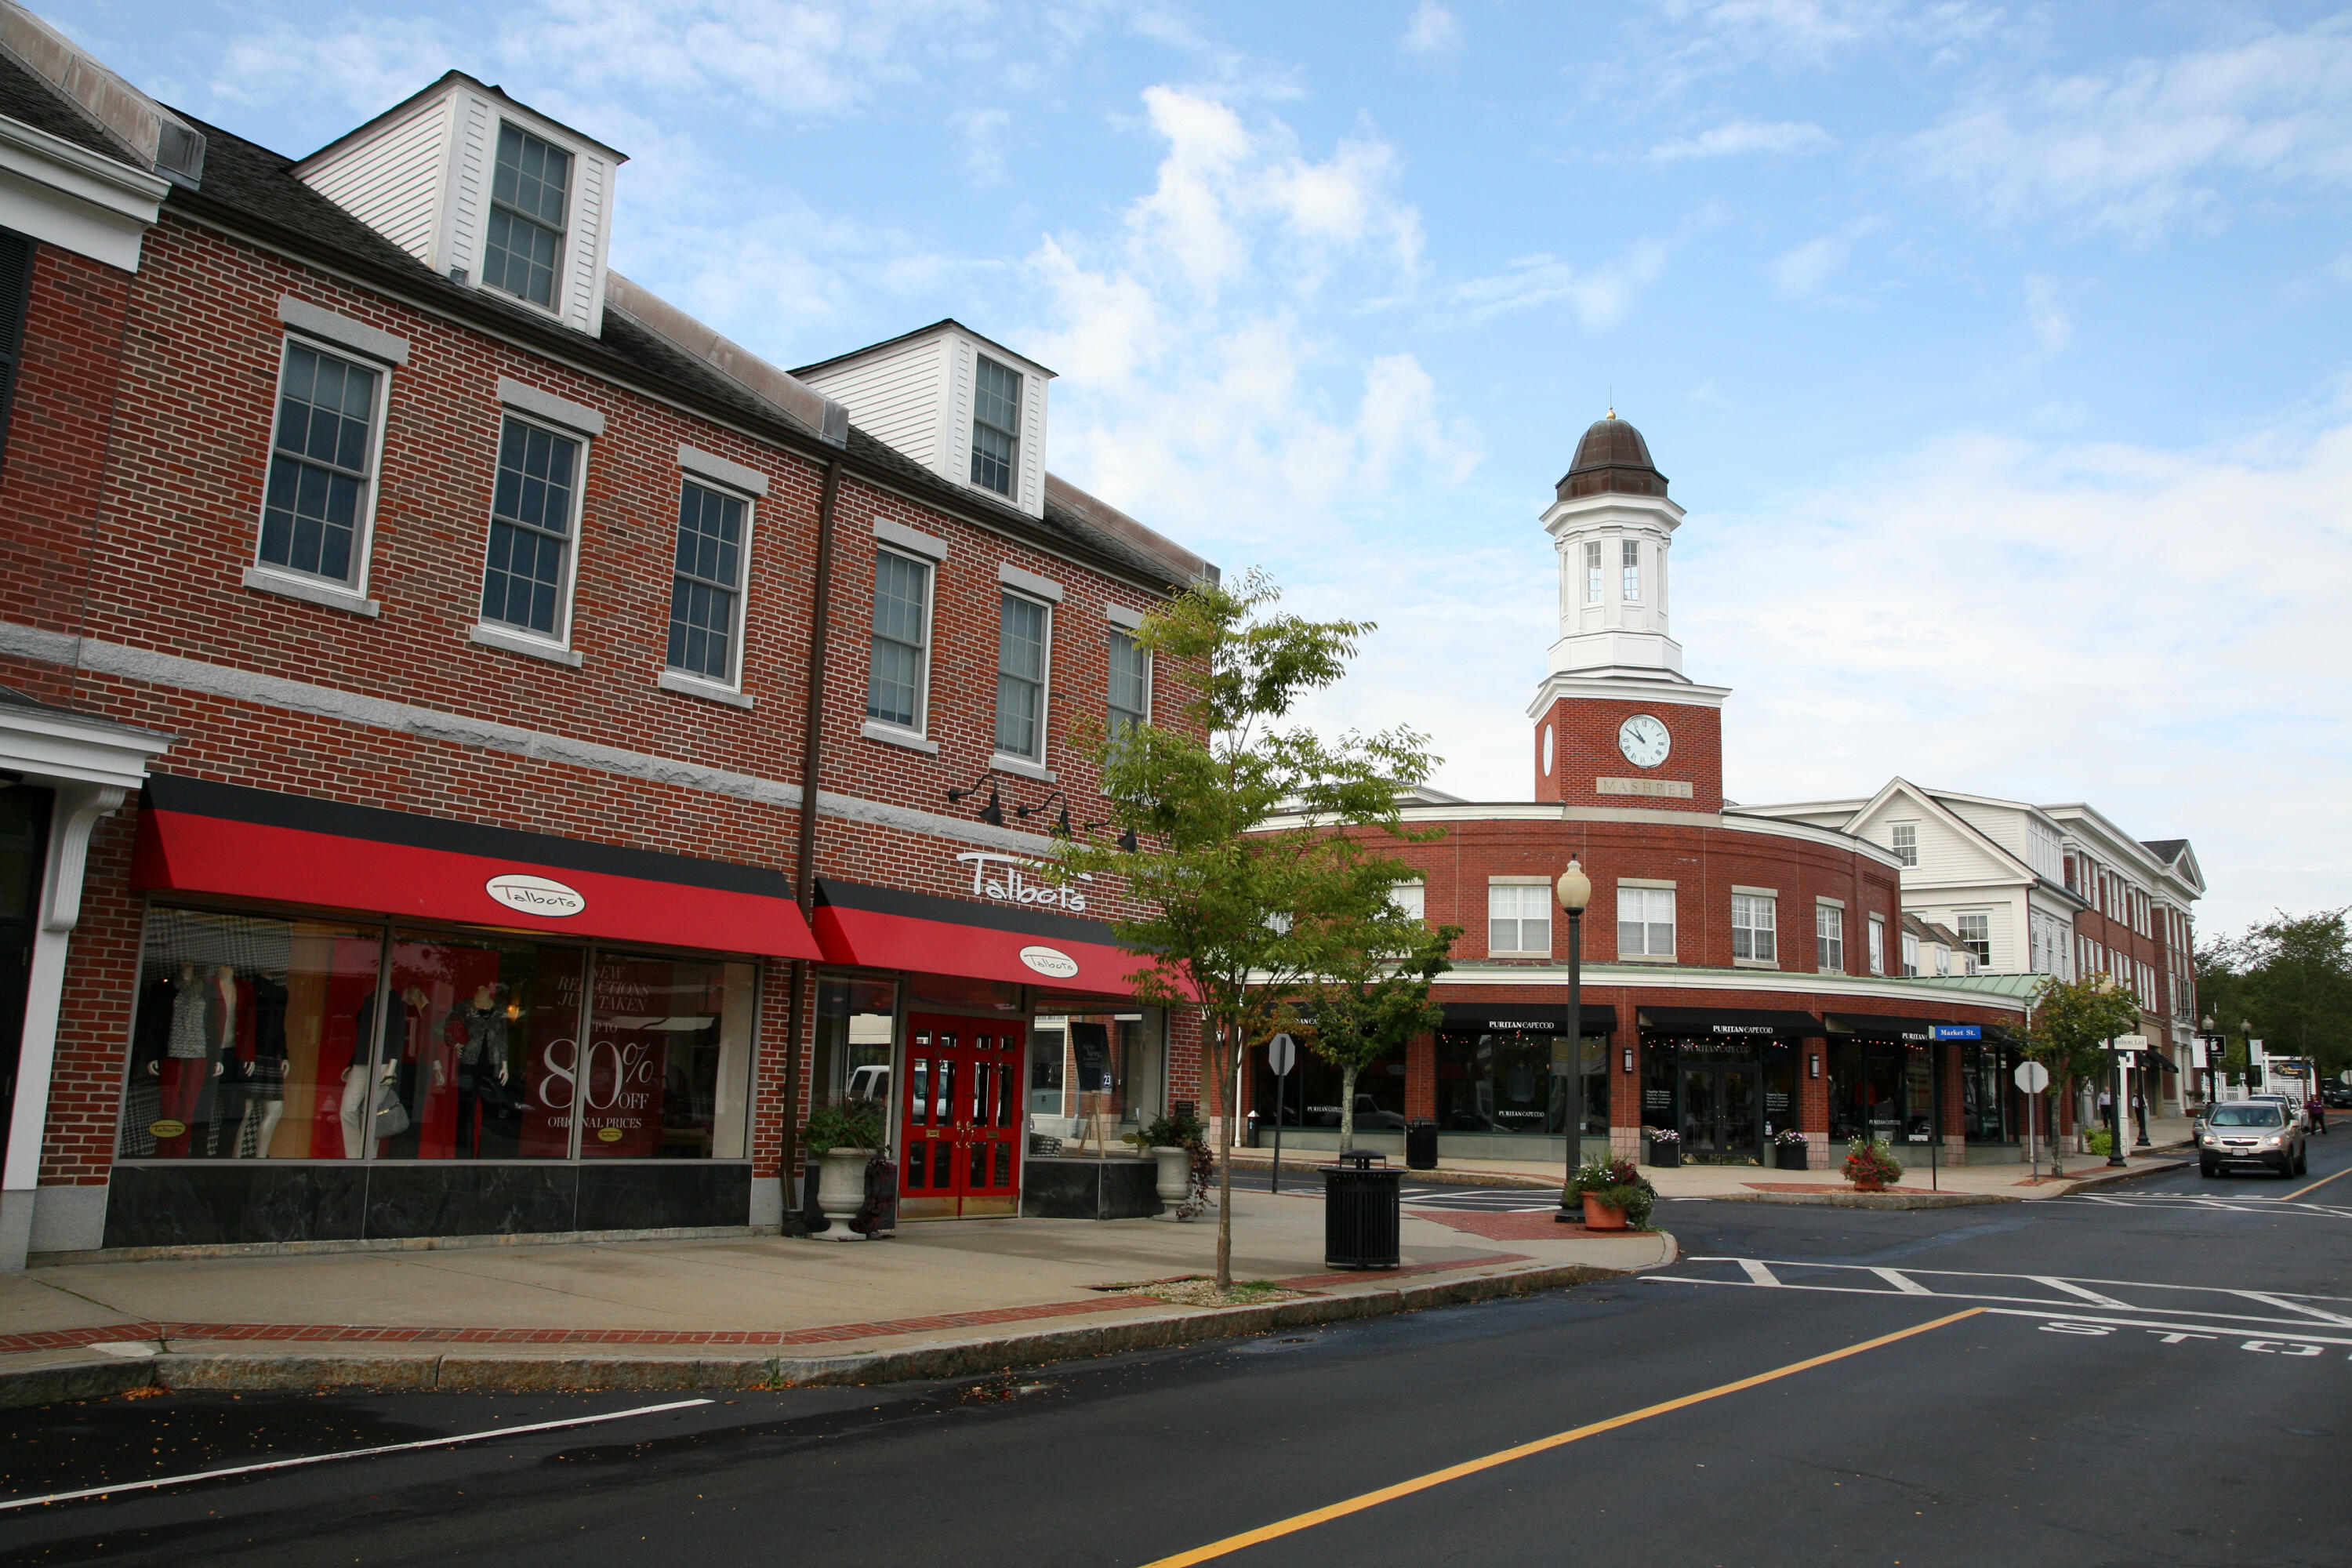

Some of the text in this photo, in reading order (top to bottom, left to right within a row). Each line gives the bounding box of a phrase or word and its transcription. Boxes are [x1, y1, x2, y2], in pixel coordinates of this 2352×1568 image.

[1603, 780, 1688, 796] MASHPEE
[956, 851, 1092, 911] Talbots
[492, 884, 576, 908] Talbots
[1023, 954, 1073, 971] Talbots
[557, 976, 651, 997] RECTIONS
[599, 994, 648, 1011] TAKEN
[1489, 1021, 1522, 1029] PURITAN
[1713, 1025, 1744, 1034] PURITAN
[1901, 1032, 1926, 1041] PURITAN
[539, 1038, 654, 1109] 80%
[618, 1091, 650, 1109] OFF
[547, 1116, 642, 1128] ORINAL PRICES
[2038, 1320, 2352, 1360] STO
